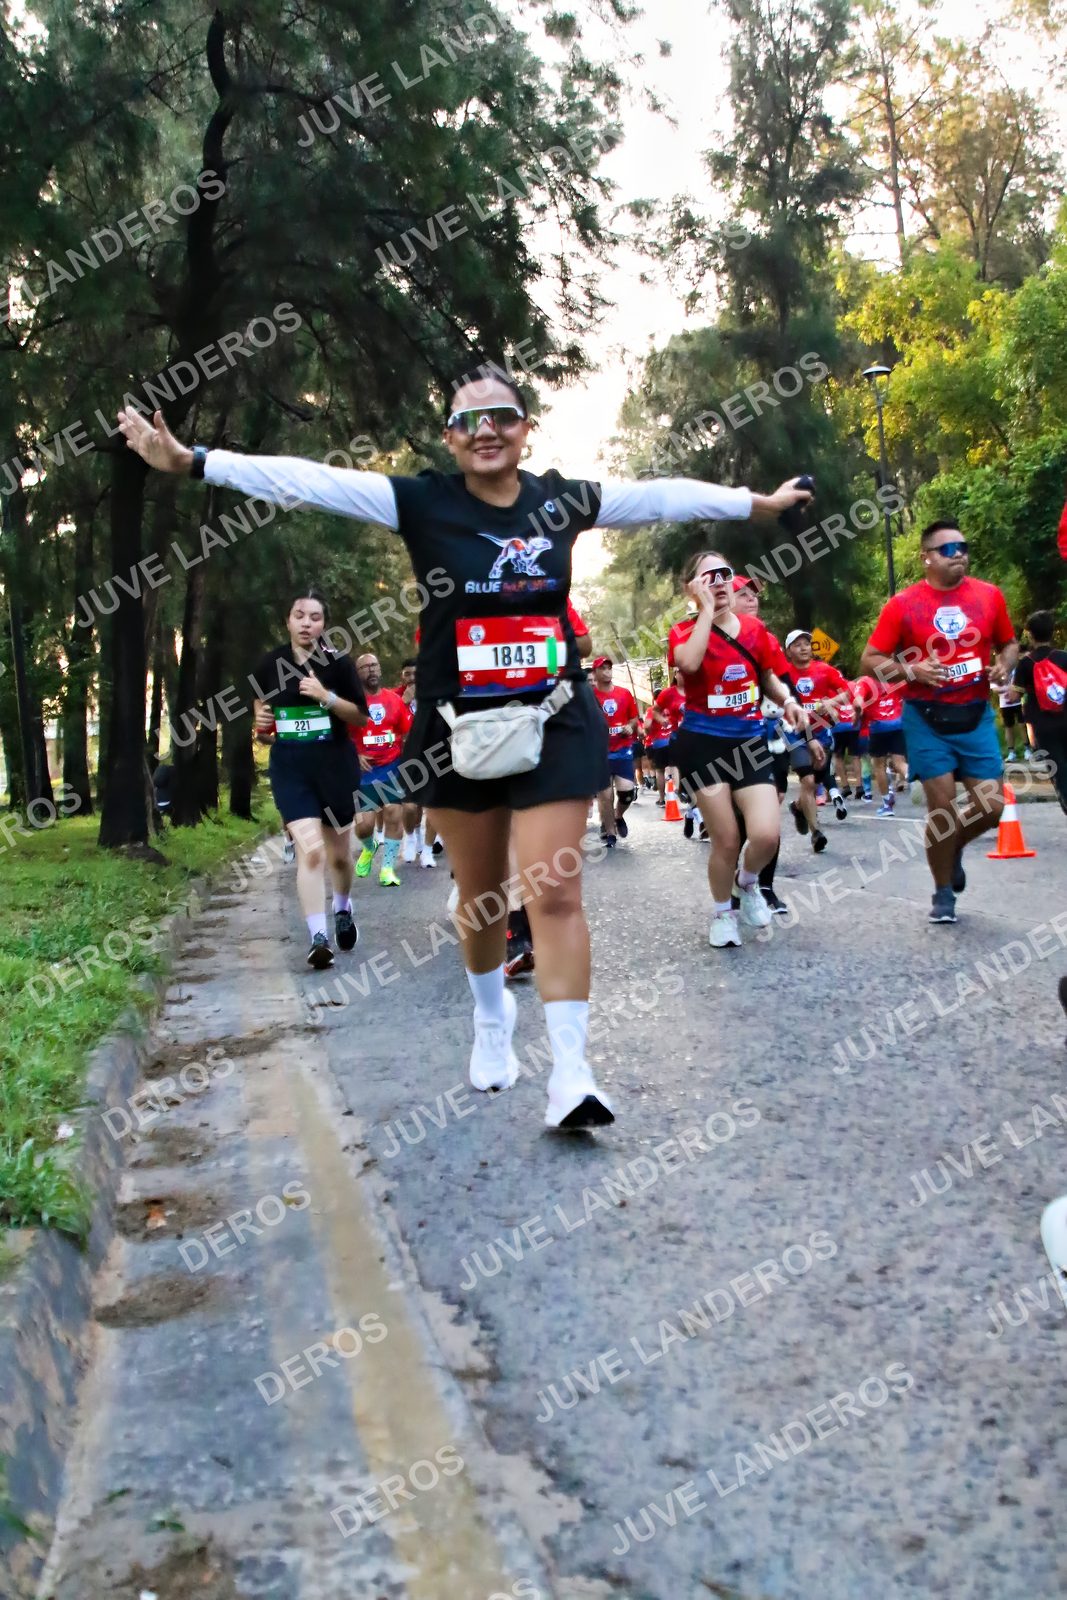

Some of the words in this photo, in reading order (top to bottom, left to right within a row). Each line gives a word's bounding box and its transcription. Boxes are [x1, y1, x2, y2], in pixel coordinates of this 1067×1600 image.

[465, 580, 501, 593] BLUE
[491, 644, 536, 667] 1843
[725, 692, 748, 707] 2499
[294, 720, 310, 731] 221
